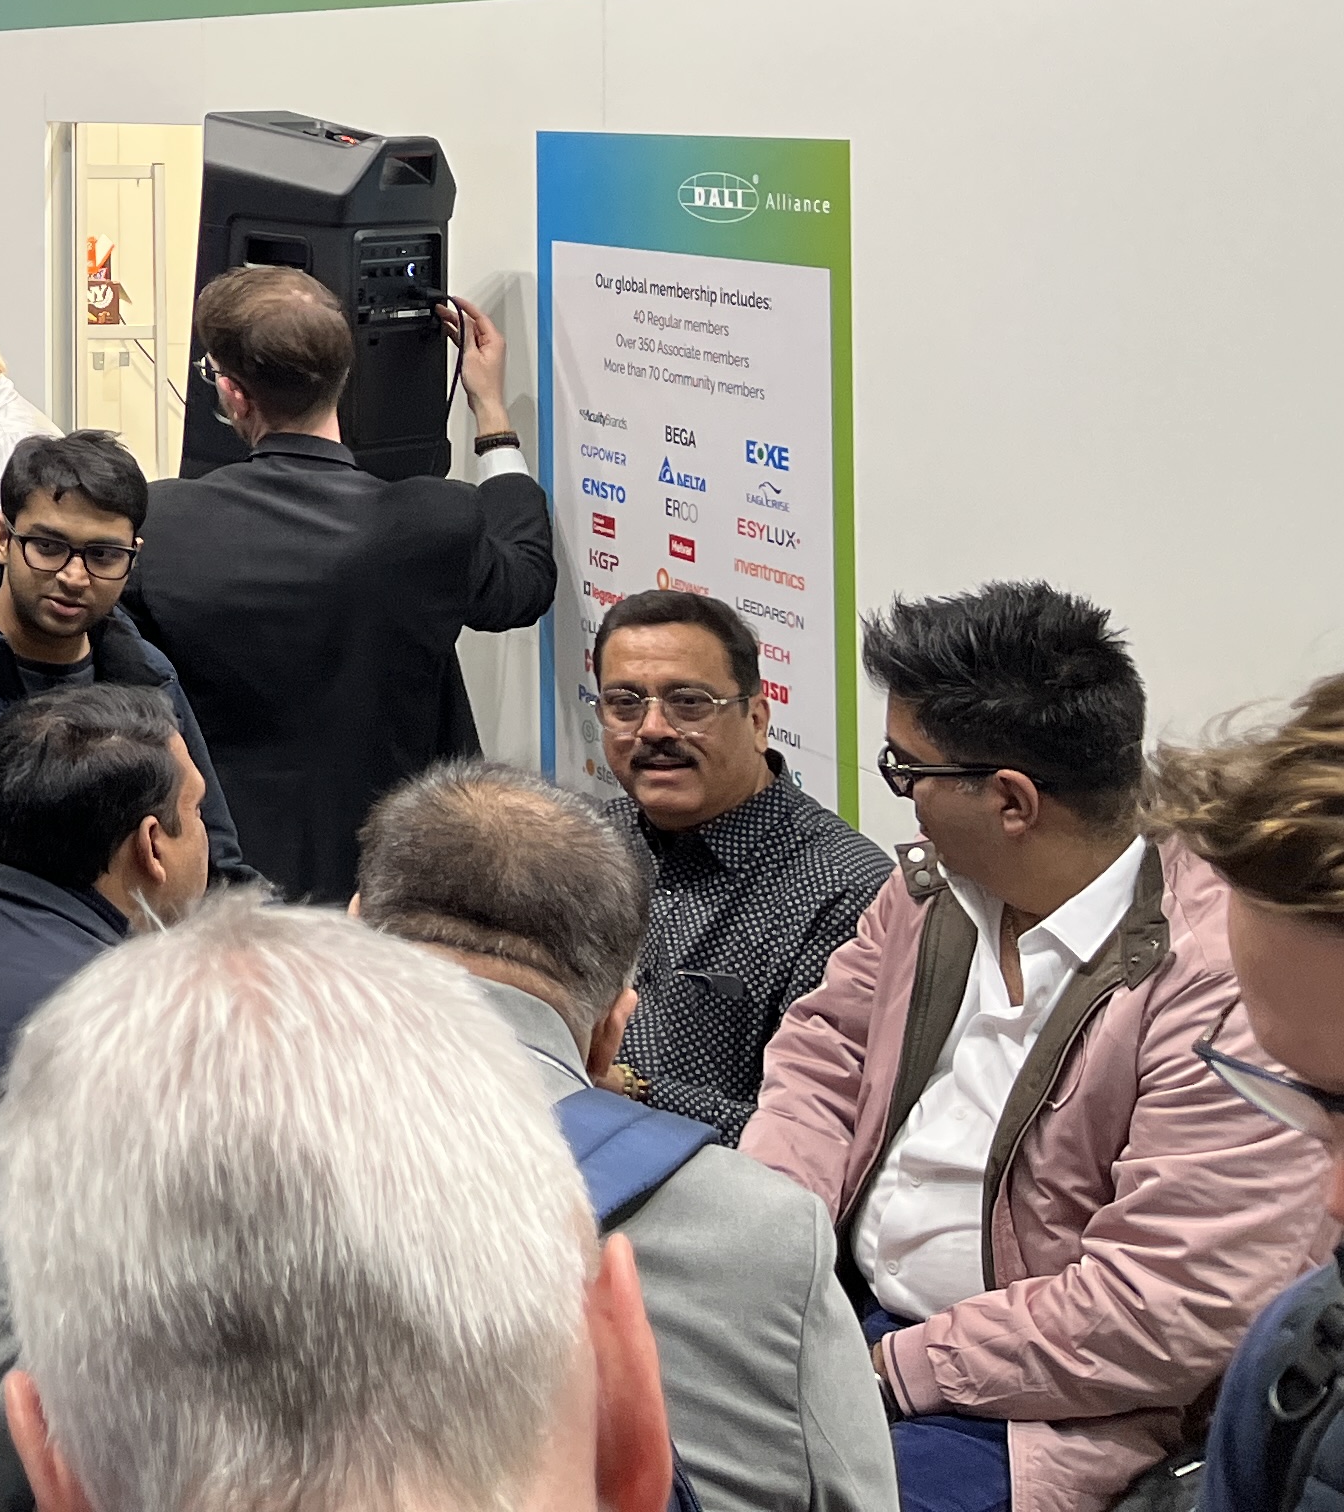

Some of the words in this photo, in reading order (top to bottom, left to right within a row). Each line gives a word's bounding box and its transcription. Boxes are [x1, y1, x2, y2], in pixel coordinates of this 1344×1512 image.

[694, 186, 743, 209] DALI
[766, 193, 830, 213] Alliance
[596, 273, 613, 289] Our
[615, 276, 647, 295] global
[650, 282, 717, 307] membership
[634, 310, 645, 324] 40
[647, 311, 682, 330] Regular
[684, 320, 729, 336] members
[616, 334, 636, 349] Over
[638, 337, 655, 352] 350
[657, 340, 701, 360] Associate
[703, 351, 749, 368] members
[604, 358, 625, 374] More
[627, 362, 646, 377] than
[649, 366, 660, 380] 70
[662, 368, 715, 395] Community
[717, 382, 765, 400] members
[666, 425, 696, 448] BEGA
[582, 478, 625, 503] ENSTO
[666, 498, 697, 523] ERCO
[738, 518, 796, 549] ESYLUX
[736, 597, 804, 629] LEEDARSON
